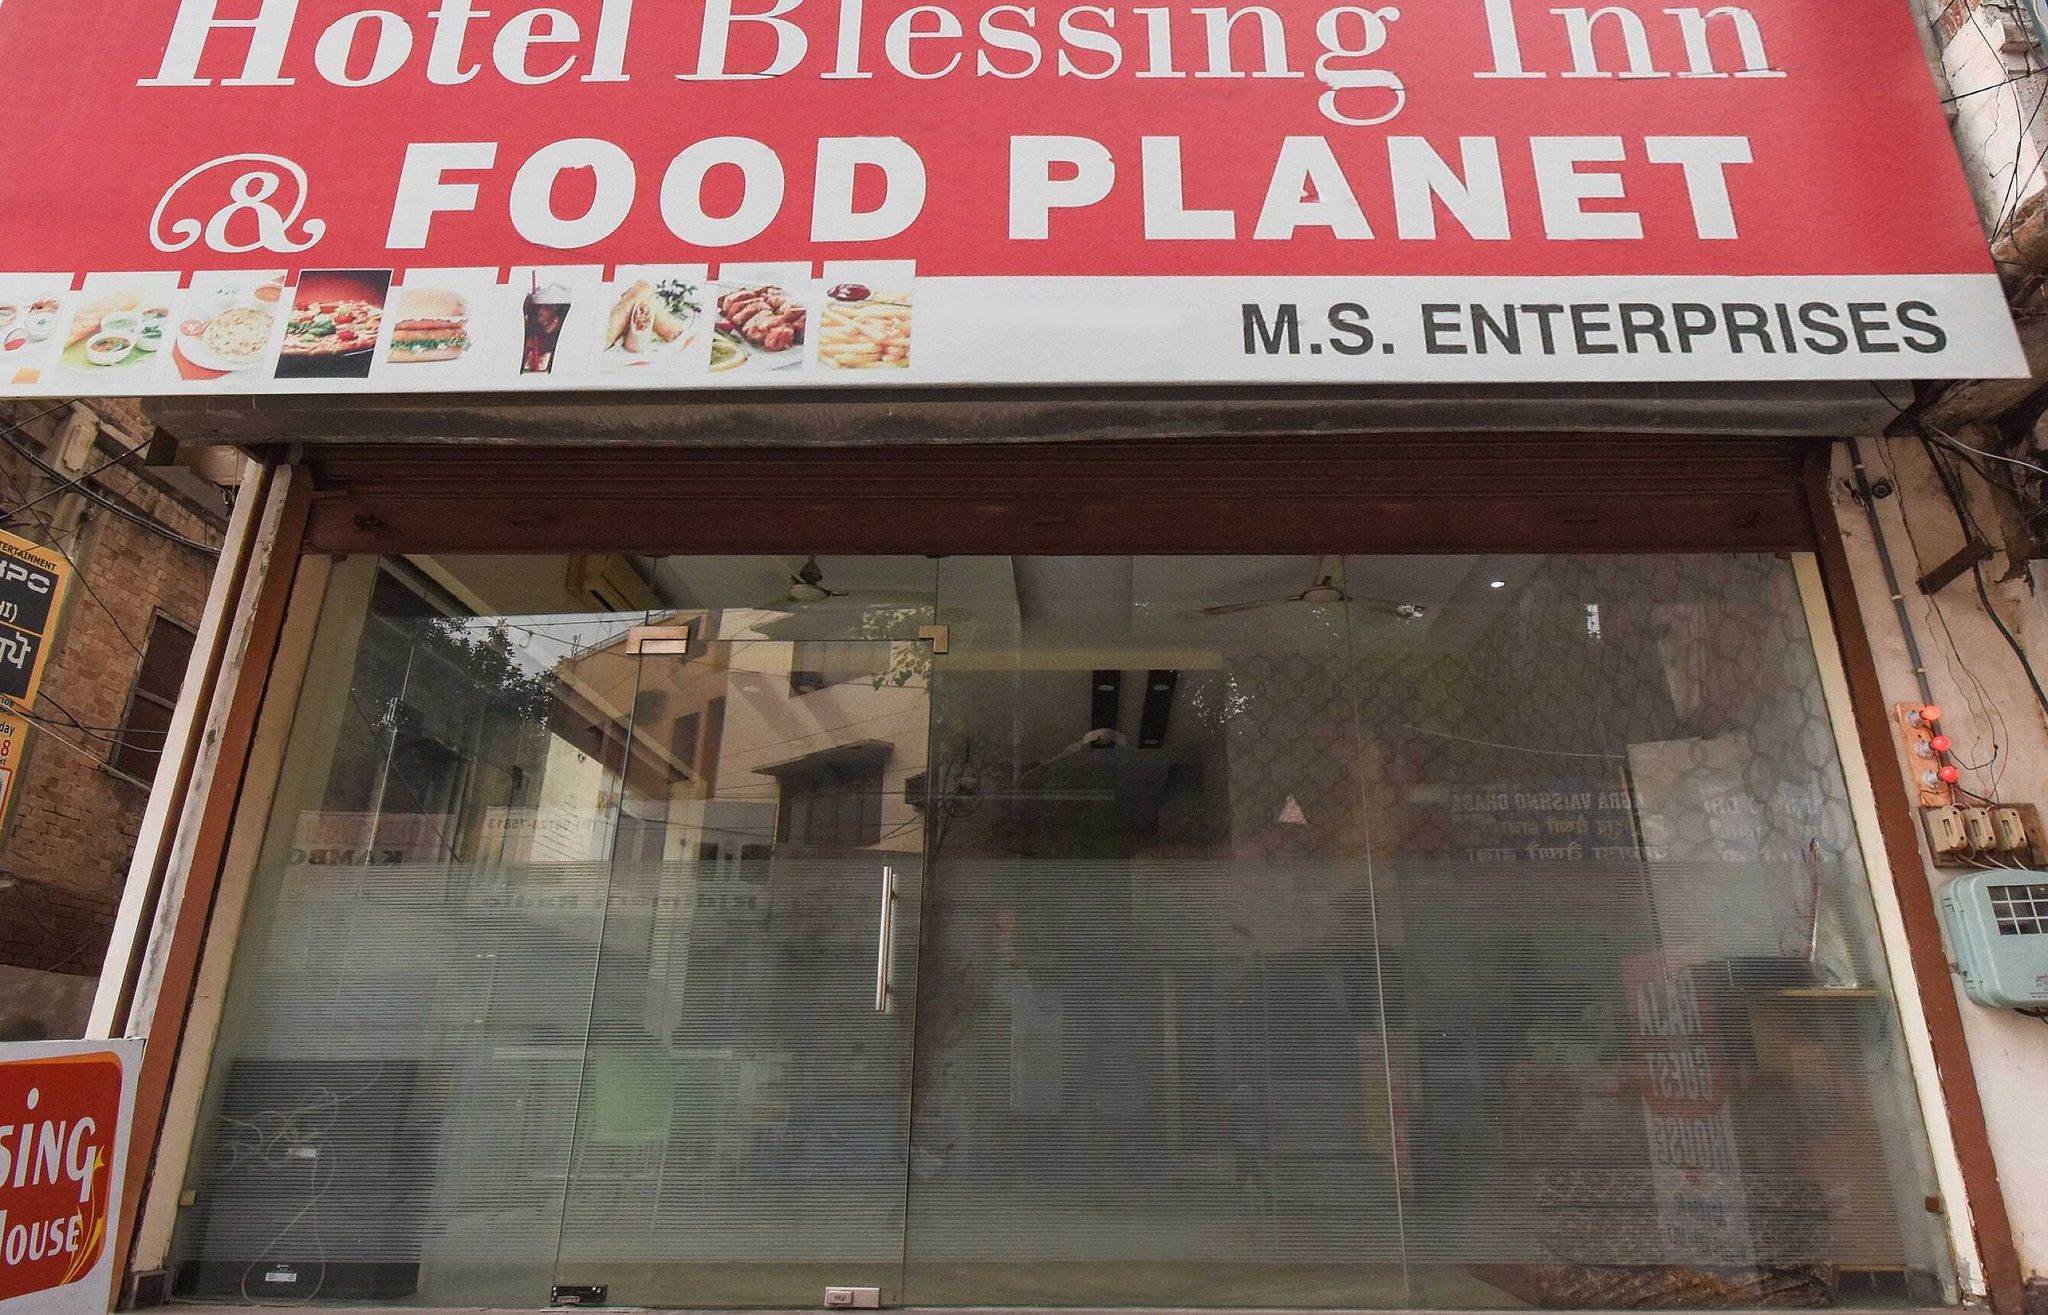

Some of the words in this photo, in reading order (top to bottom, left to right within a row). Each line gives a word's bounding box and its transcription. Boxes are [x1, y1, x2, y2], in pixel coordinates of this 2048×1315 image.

[137, 0, 633, 87] Hotel
[676, 0, 1406, 126] Blessing
[1473, 0, 1787, 80] Inn
[150, 153, 326, 253] &
[386, 136, 926, 250] FOOD
[1009, 135, 1754, 241] PLANET
[1242, 302, 1395, 356] M.S.
[1422, 301, 1947, 355] ENTERPRISES
